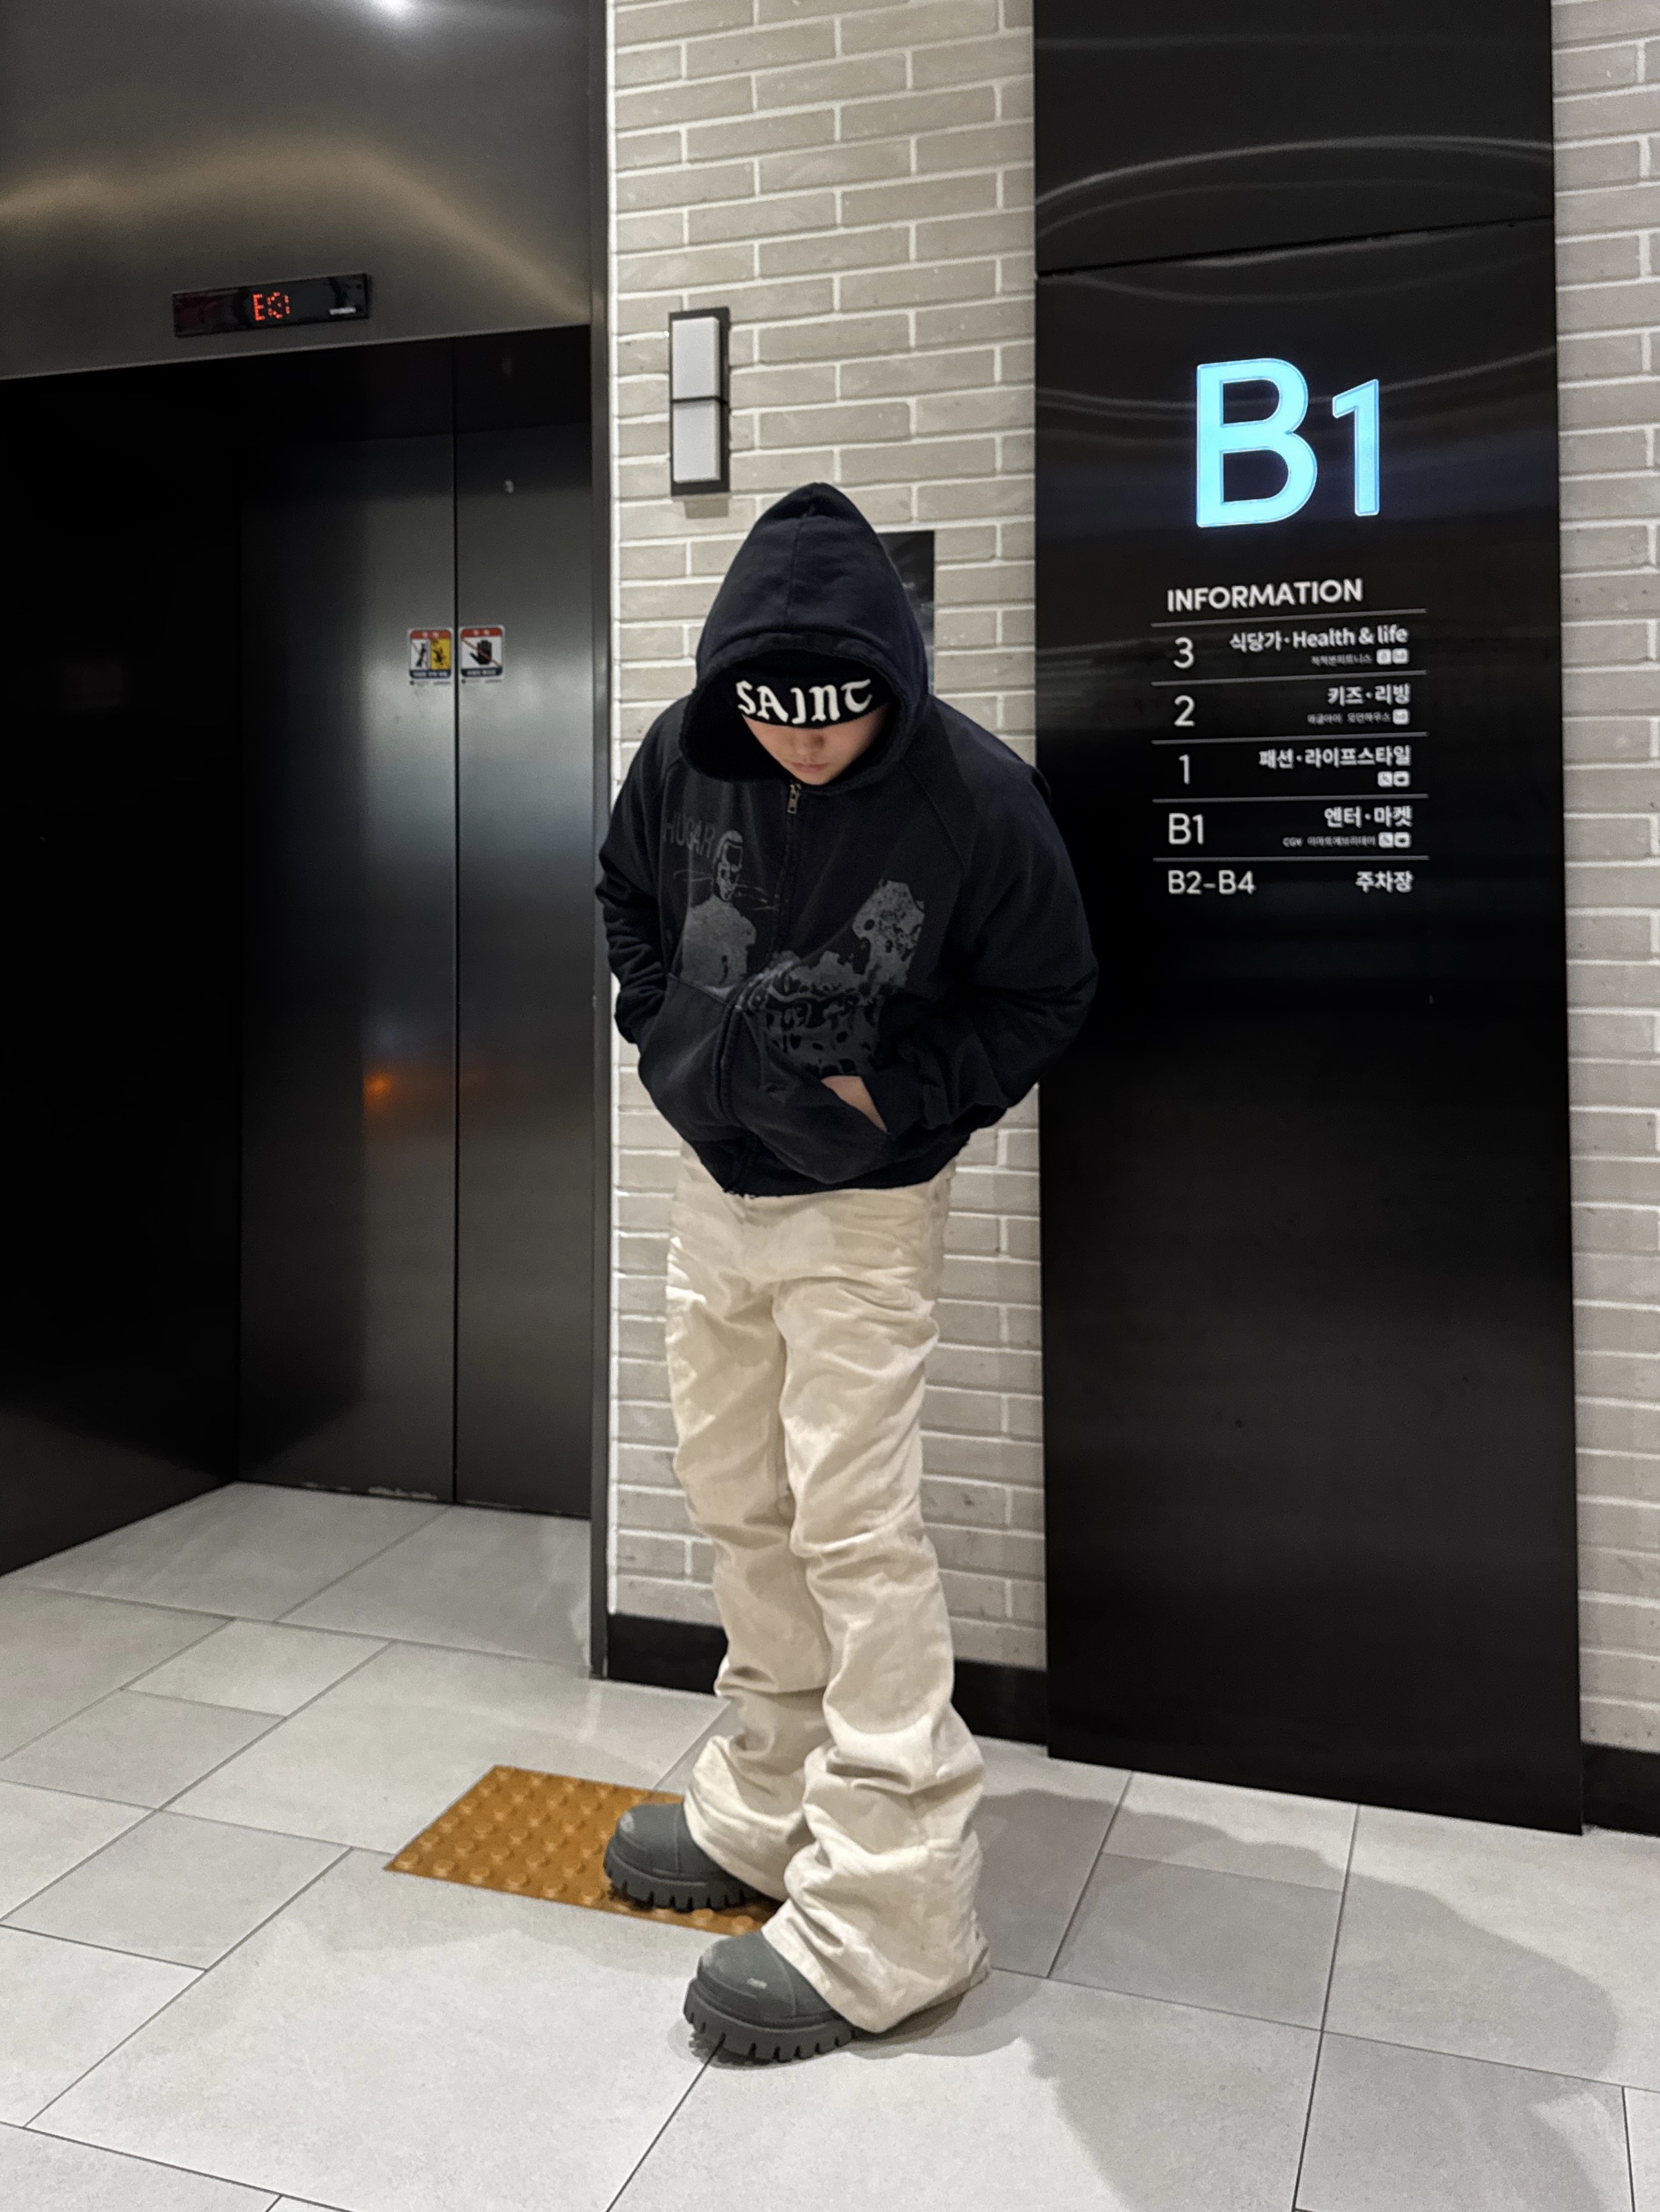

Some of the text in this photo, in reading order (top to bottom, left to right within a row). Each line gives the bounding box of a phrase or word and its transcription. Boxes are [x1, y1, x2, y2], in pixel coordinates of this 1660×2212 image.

[1196, 357, 1380, 528] B1
[1167, 578, 1363, 612] INFORMATION
[1358, 627, 1374, 645] &
[1377, 623, 1409, 644] life
[1173, 636, 1194, 669] 3
[736, 679, 872, 724] SAINT
[1328, 683, 1410, 706] 키즈·리빙
[1174, 694, 1195, 727] 2
[1179, 754, 1190, 785] 1
[1259, 745, 1411, 769] 패션·라이프스타일
[1168, 812, 1203, 845] B1
[1324, 805, 1412, 828] 엔터·마켓
[1168, 869, 1256, 894] B2-B4
[1355, 870, 1413, 893] 주차장
